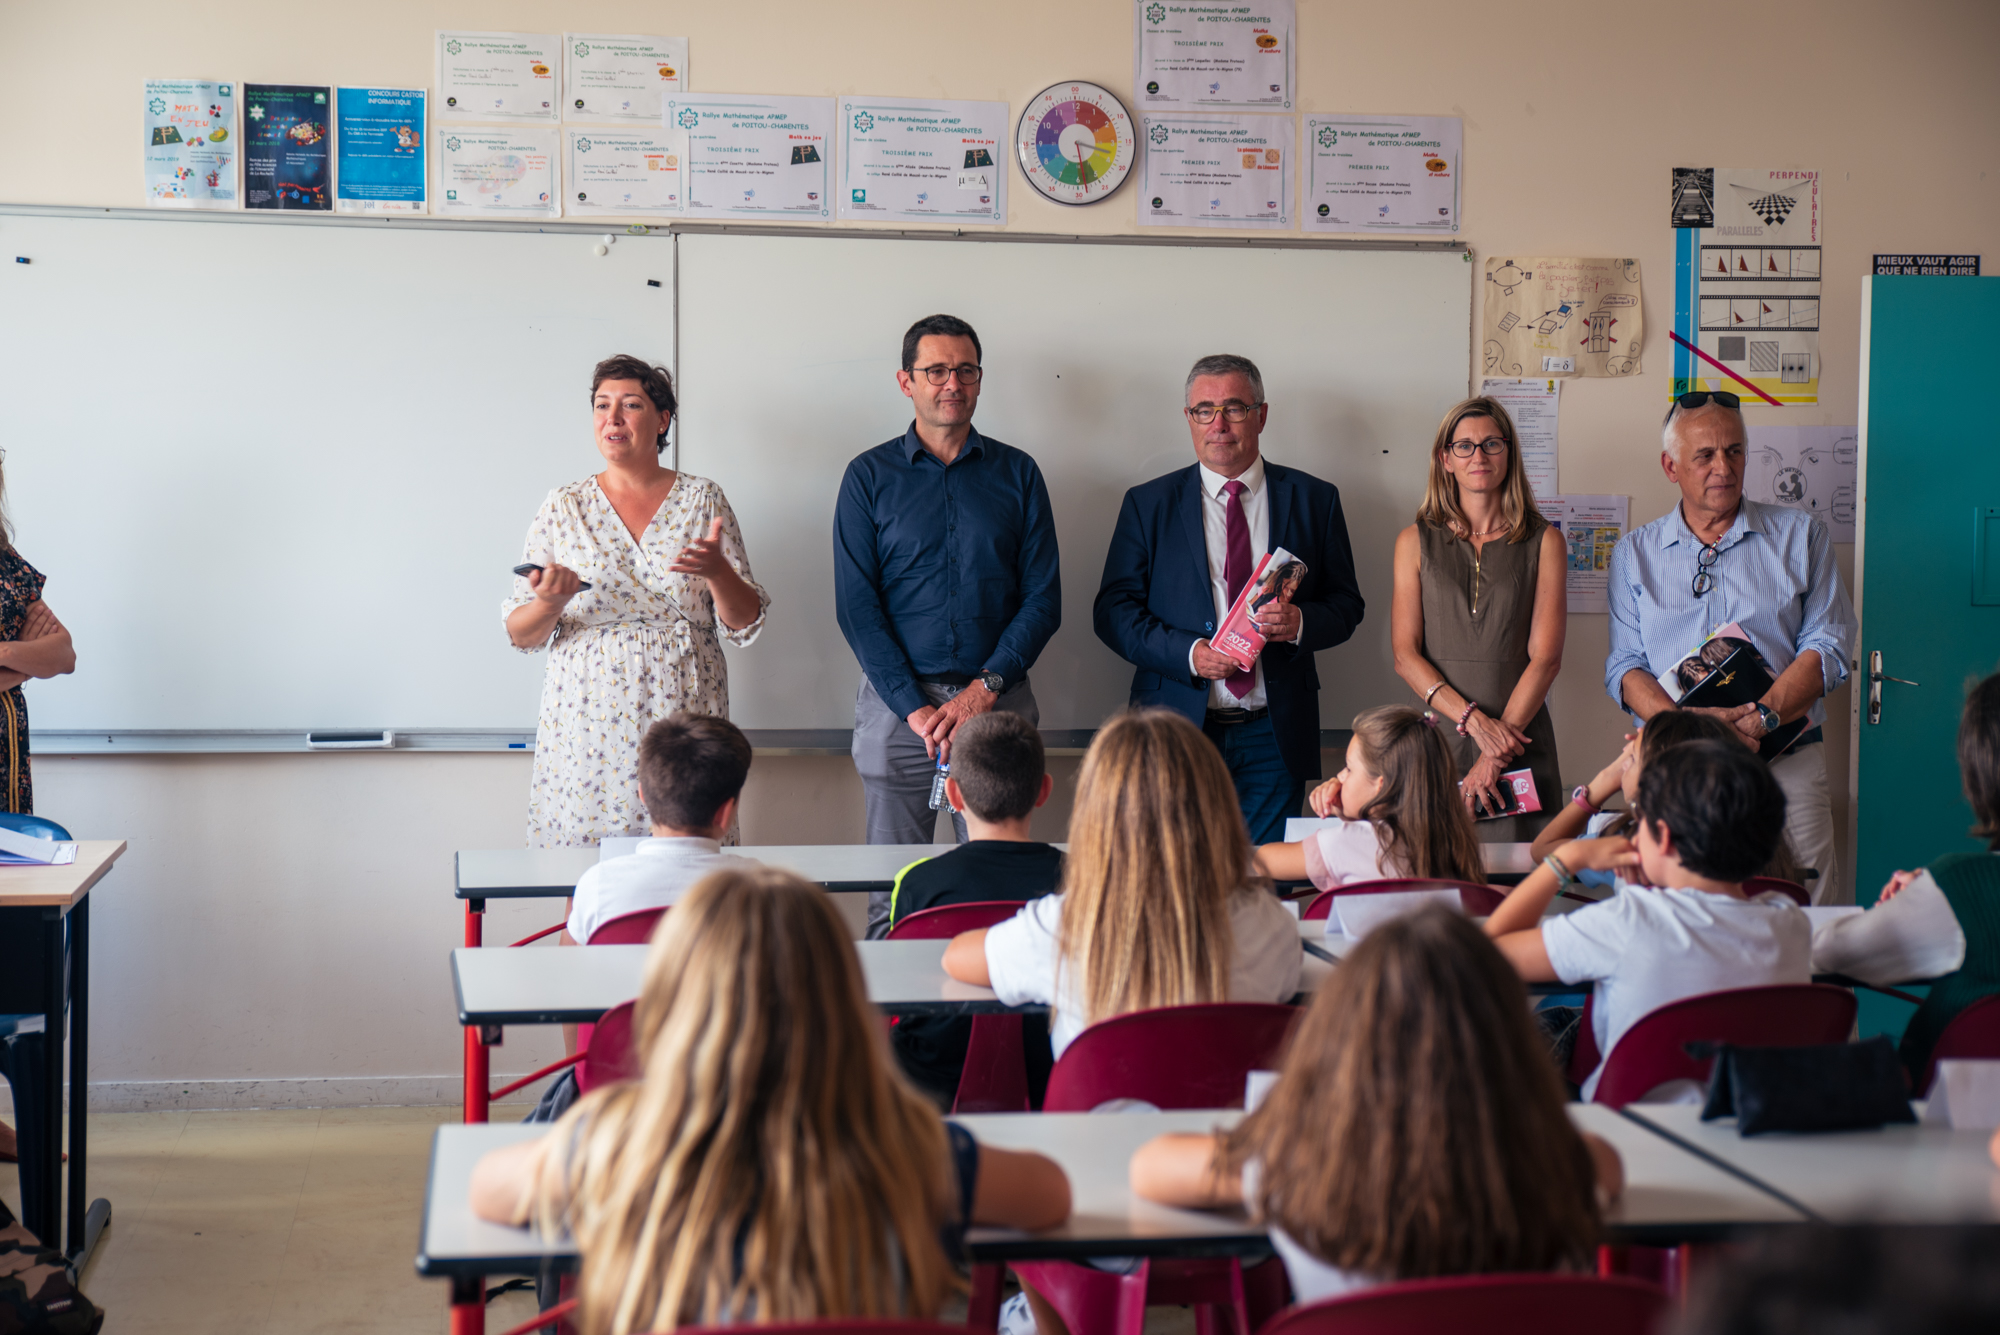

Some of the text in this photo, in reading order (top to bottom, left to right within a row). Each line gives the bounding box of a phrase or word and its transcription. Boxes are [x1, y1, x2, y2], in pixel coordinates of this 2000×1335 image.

[175, 104, 198, 112] MATH
[1717, 226, 1764, 236] PARALLELES
[1877, 256, 1976, 266] MIEUX VAUT AGIR
[1877, 267, 1976, 275] QUE NE RIEN DIRE
[1226, 632, 1251, 651] 2022
